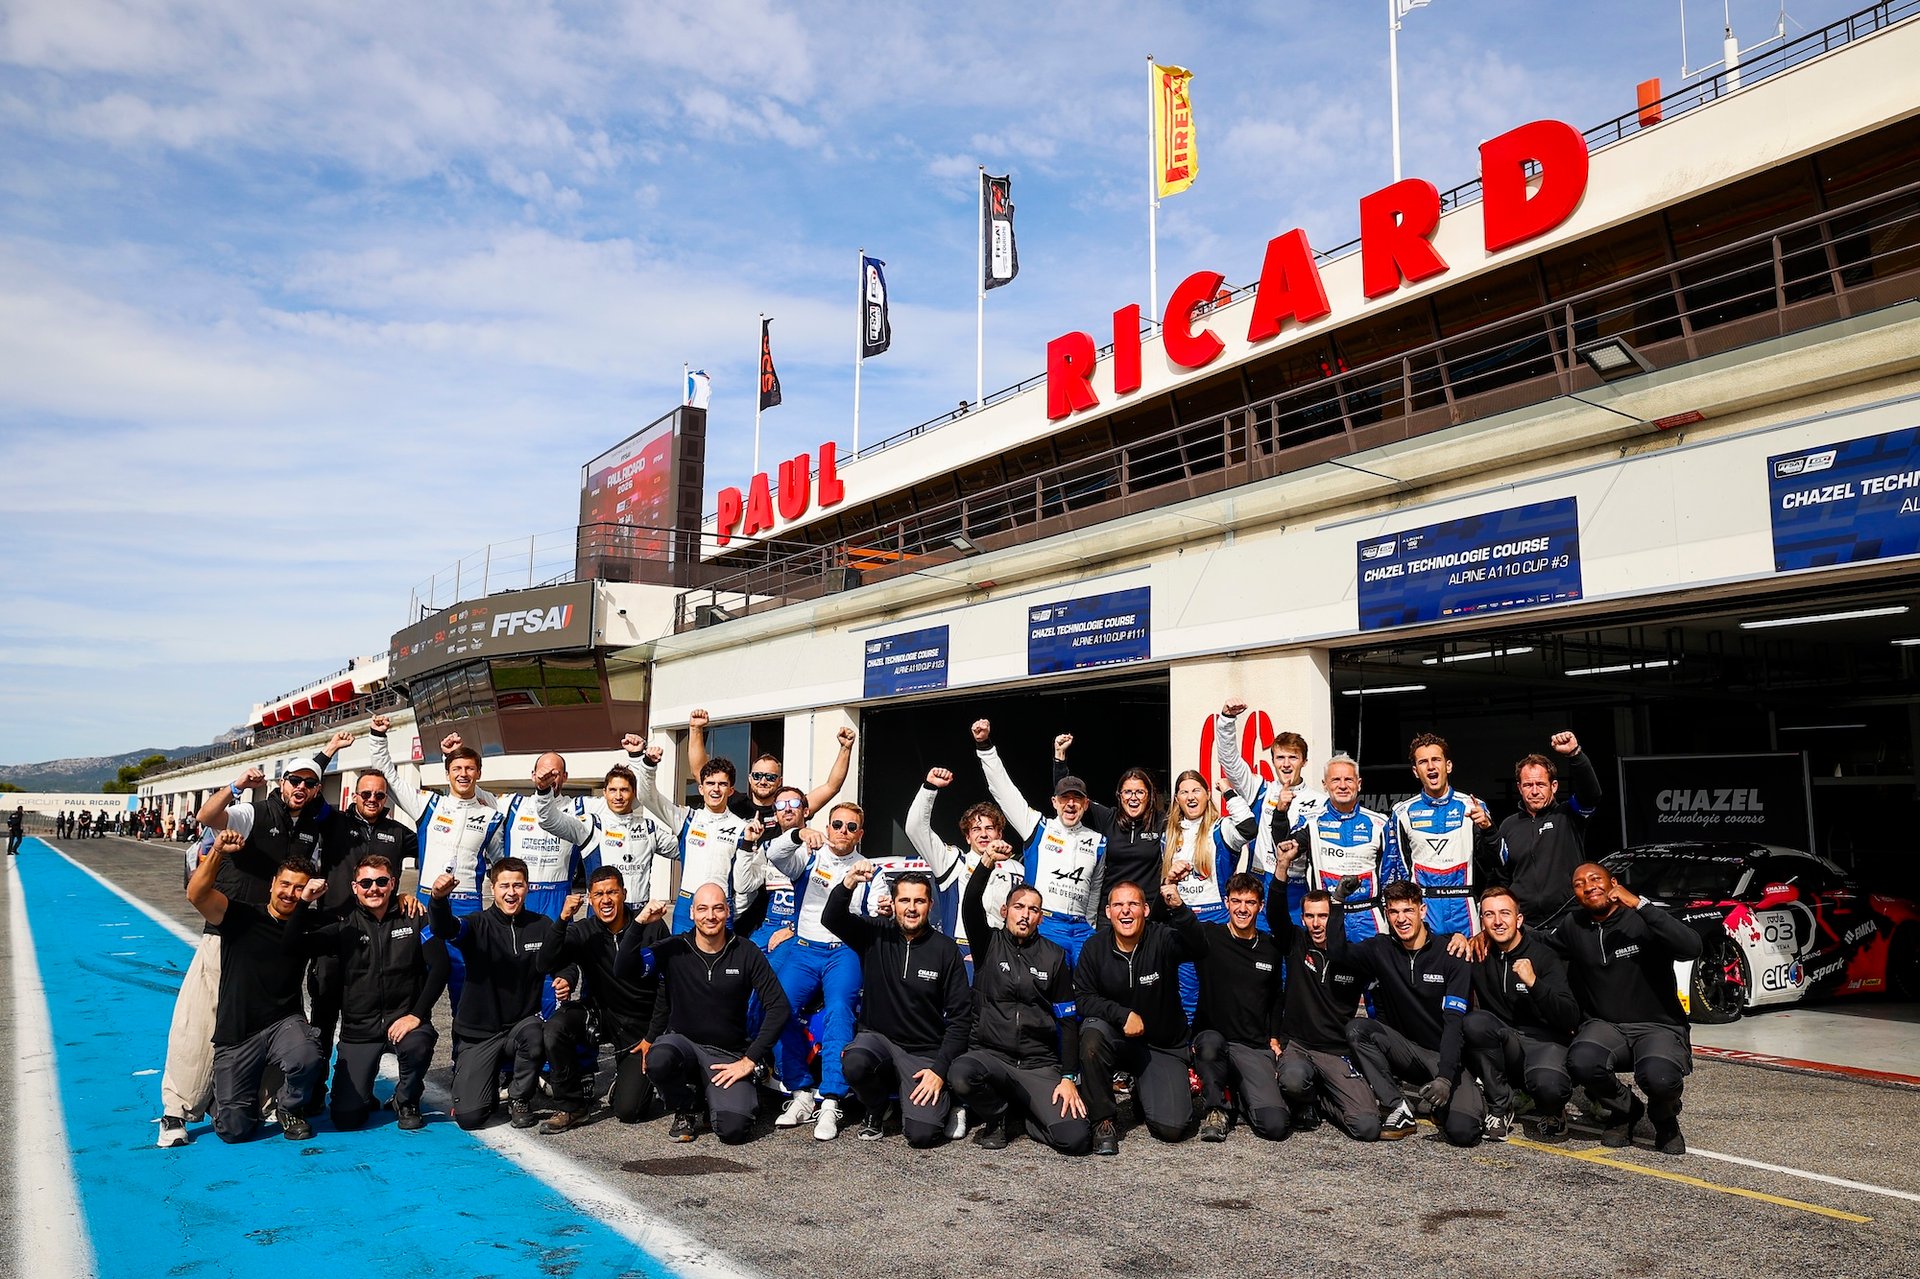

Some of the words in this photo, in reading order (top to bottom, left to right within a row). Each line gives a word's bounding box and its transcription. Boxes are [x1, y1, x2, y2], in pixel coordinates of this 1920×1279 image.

[717, 441, 844, 547] PAUL
[1047, 119, 1589, 420] RICARD
[607, 470, 622, 488] PAUL
[622, 457, 646, 479] RICARD
[617, 480, 634, 495] 2026
[1782, 482, 1856, 509] CHAZEL
[1364, 563, 1405, 582] CHAZEL
[1407, 546, 1491, 576] TECHNOLOGIE
[1492, 537, 1550, 560] COURSE
[1448, 569, 1487, 586] ALPINE
[1488, 562, 1521, 580] A110
[1522, 558, 1549, 574] CUP
[1551, 554, 1569, 570] #3
[491, 605, 564, 638] FFSA
[1032, 626, 1056, 640] CHAZEL
[1056, 619, 1104, 636] TECHNOLOGIE
[1104, 614, 1136, 628] COURSE
[1072, 635, 1094, 647] ALPINE
[1094, 632, 1112, 644] A110
[1112, 631, 1127, 642] CUP
[1127, 628, 1145, 640] #111
[867, 657, 884, 668] CHAZEL
[885, 651, 918, 666] TECHNOLOGIE
[918, 648, 940, 660] COURSE
[921, 661, 932, 671] CUP
[932, 659, 945, 669] #123
[1656, 788, 1764, 811] CHAZEL
[1657, 811, 1721, 828] technologie
[1724, 815, 1766, 824] course
[528, 845, 560, 853] PARTNERS
[529, 837, 560, 846] TECHNI
[1321, 847, 1345, 857] RRG
[1764, 923, 1794, 943] 03
[1614, 944, 1639, 955] CHAZEL
[1762, 963, 1789, 990] elf
[1812, 956, 1844, 980] spark
